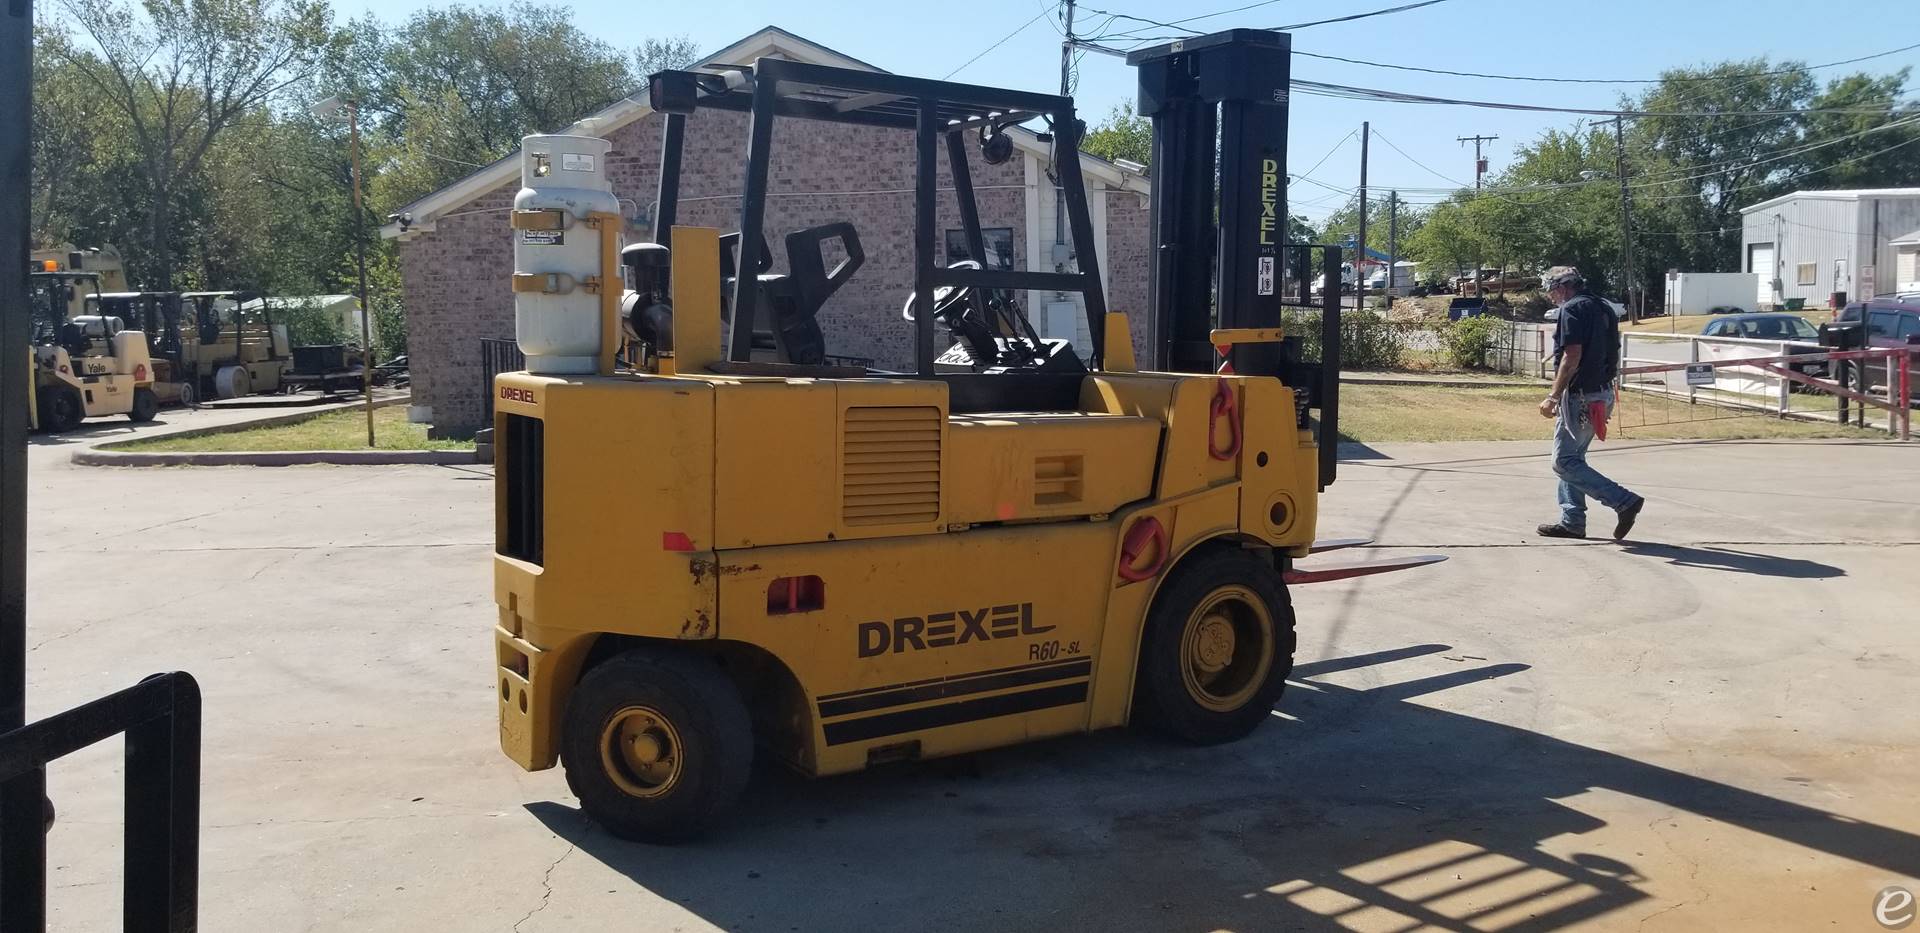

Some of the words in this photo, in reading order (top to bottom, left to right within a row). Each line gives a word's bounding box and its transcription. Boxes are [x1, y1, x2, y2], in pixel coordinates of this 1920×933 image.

[1259, 159, 1278, 245] DREXEL
[88, 363, 106, 373] Yale
[500, 386, 538, 405] DREXEL
[858, 602, 1057, 659] DREXEL
